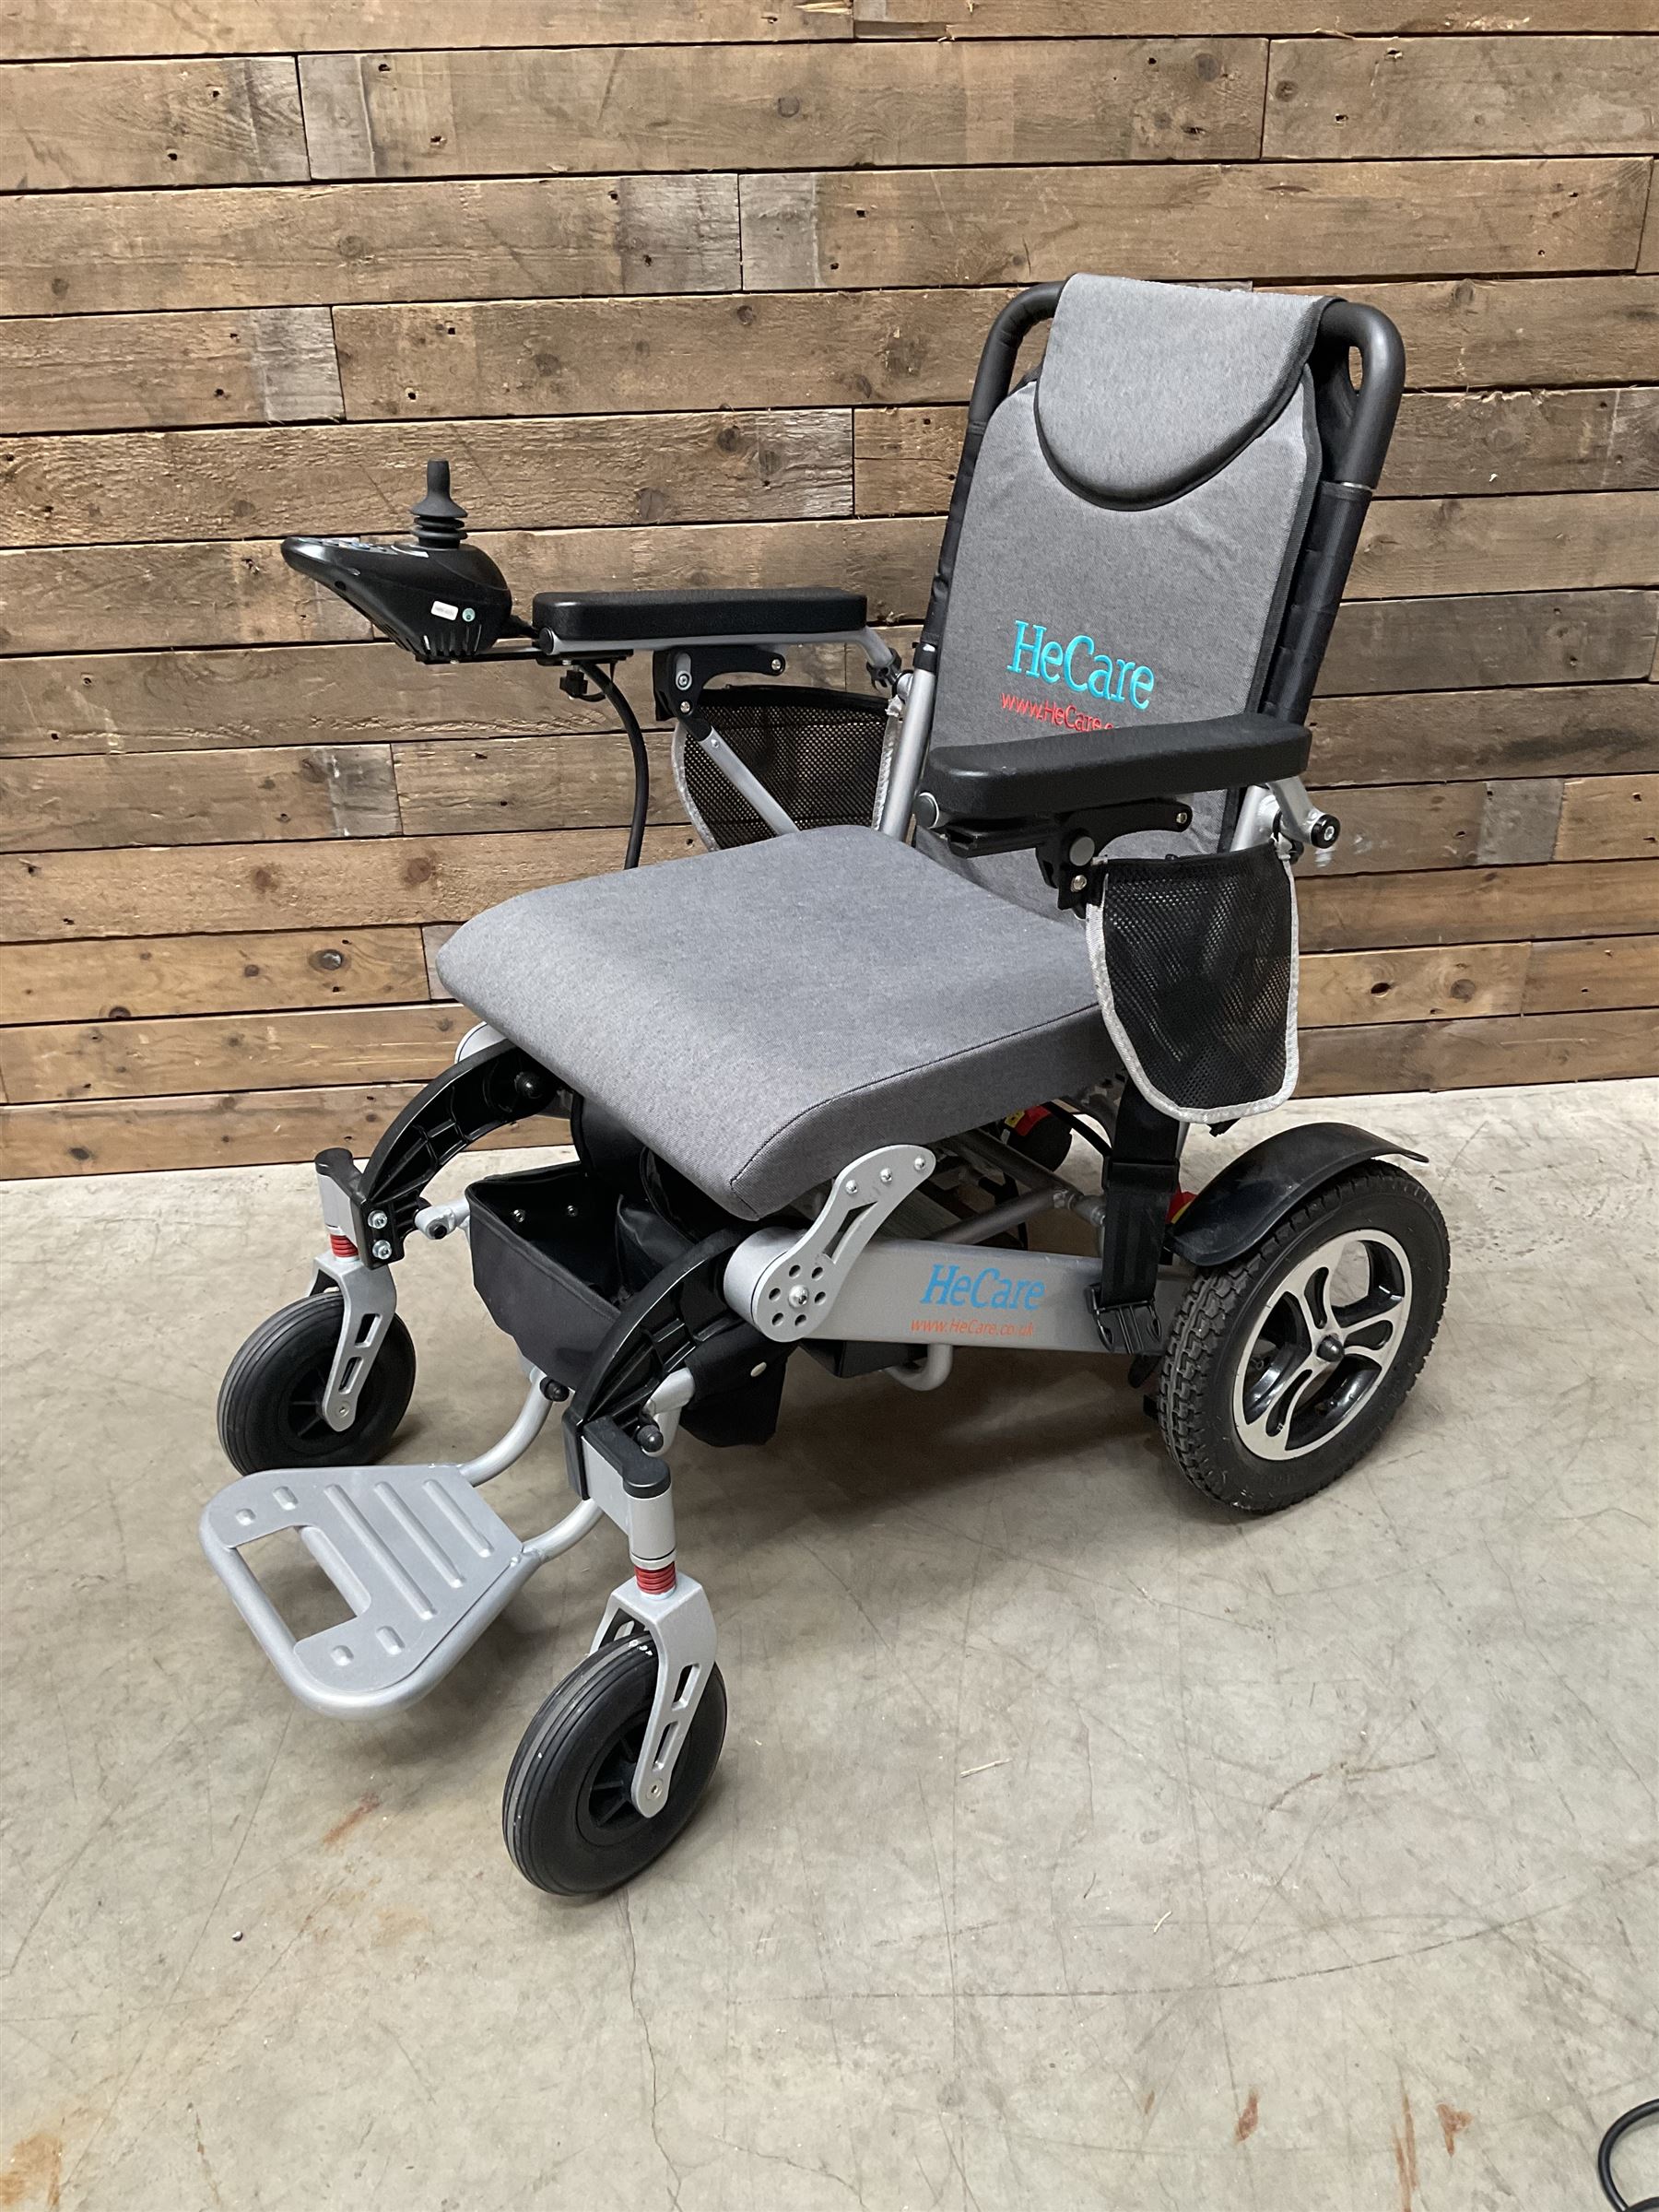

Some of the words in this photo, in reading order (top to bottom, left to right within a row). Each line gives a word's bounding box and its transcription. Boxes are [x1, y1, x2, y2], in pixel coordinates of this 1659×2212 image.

[1006, 619, 1155, 710] HeCare
[1000, 692, 1114, 732] www.HeCare
[920, 1264, 1046, 1311] HeCare
